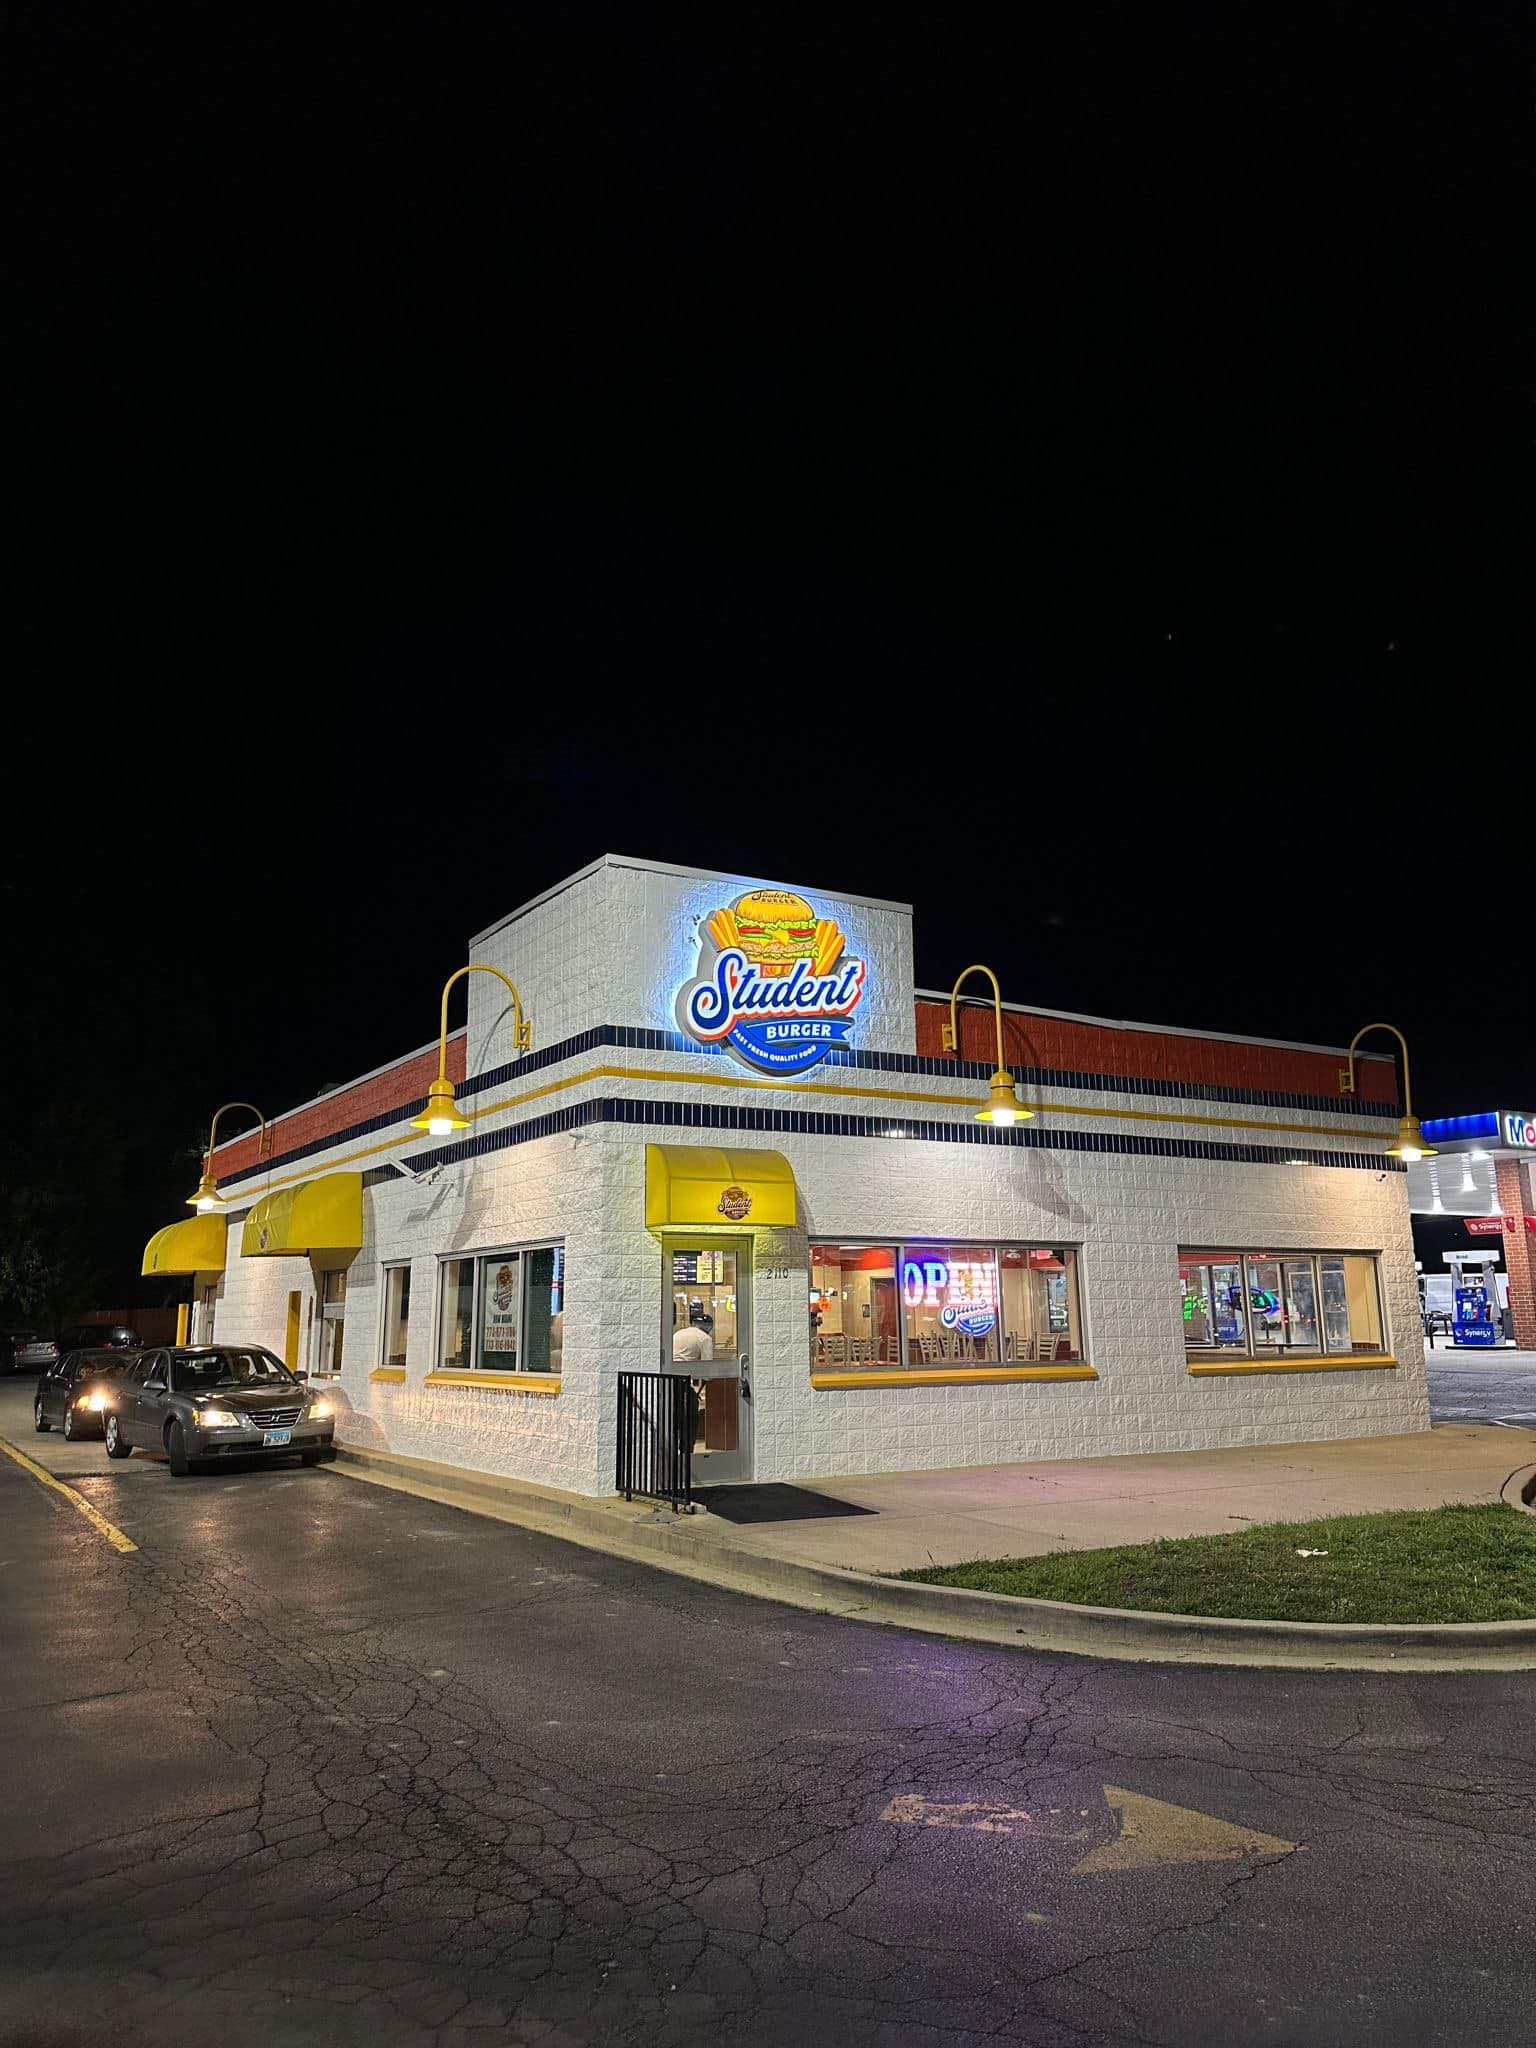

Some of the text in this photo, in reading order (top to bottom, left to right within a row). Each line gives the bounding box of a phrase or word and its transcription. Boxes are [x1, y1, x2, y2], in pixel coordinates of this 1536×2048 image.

[691, 952, 858, 1029] Student
[766, 1024, 831, 1039] BURGER
[733, 1028, 817, 1062] FAST FRESH QUALITY FOOD
[718, 1197, 752, 1212] Student
[766, 1268, 789, 1279] 2110
[904, 1262, 994, 1307] OPEN
[1465, 1328, 1491, 1337] Synergy
